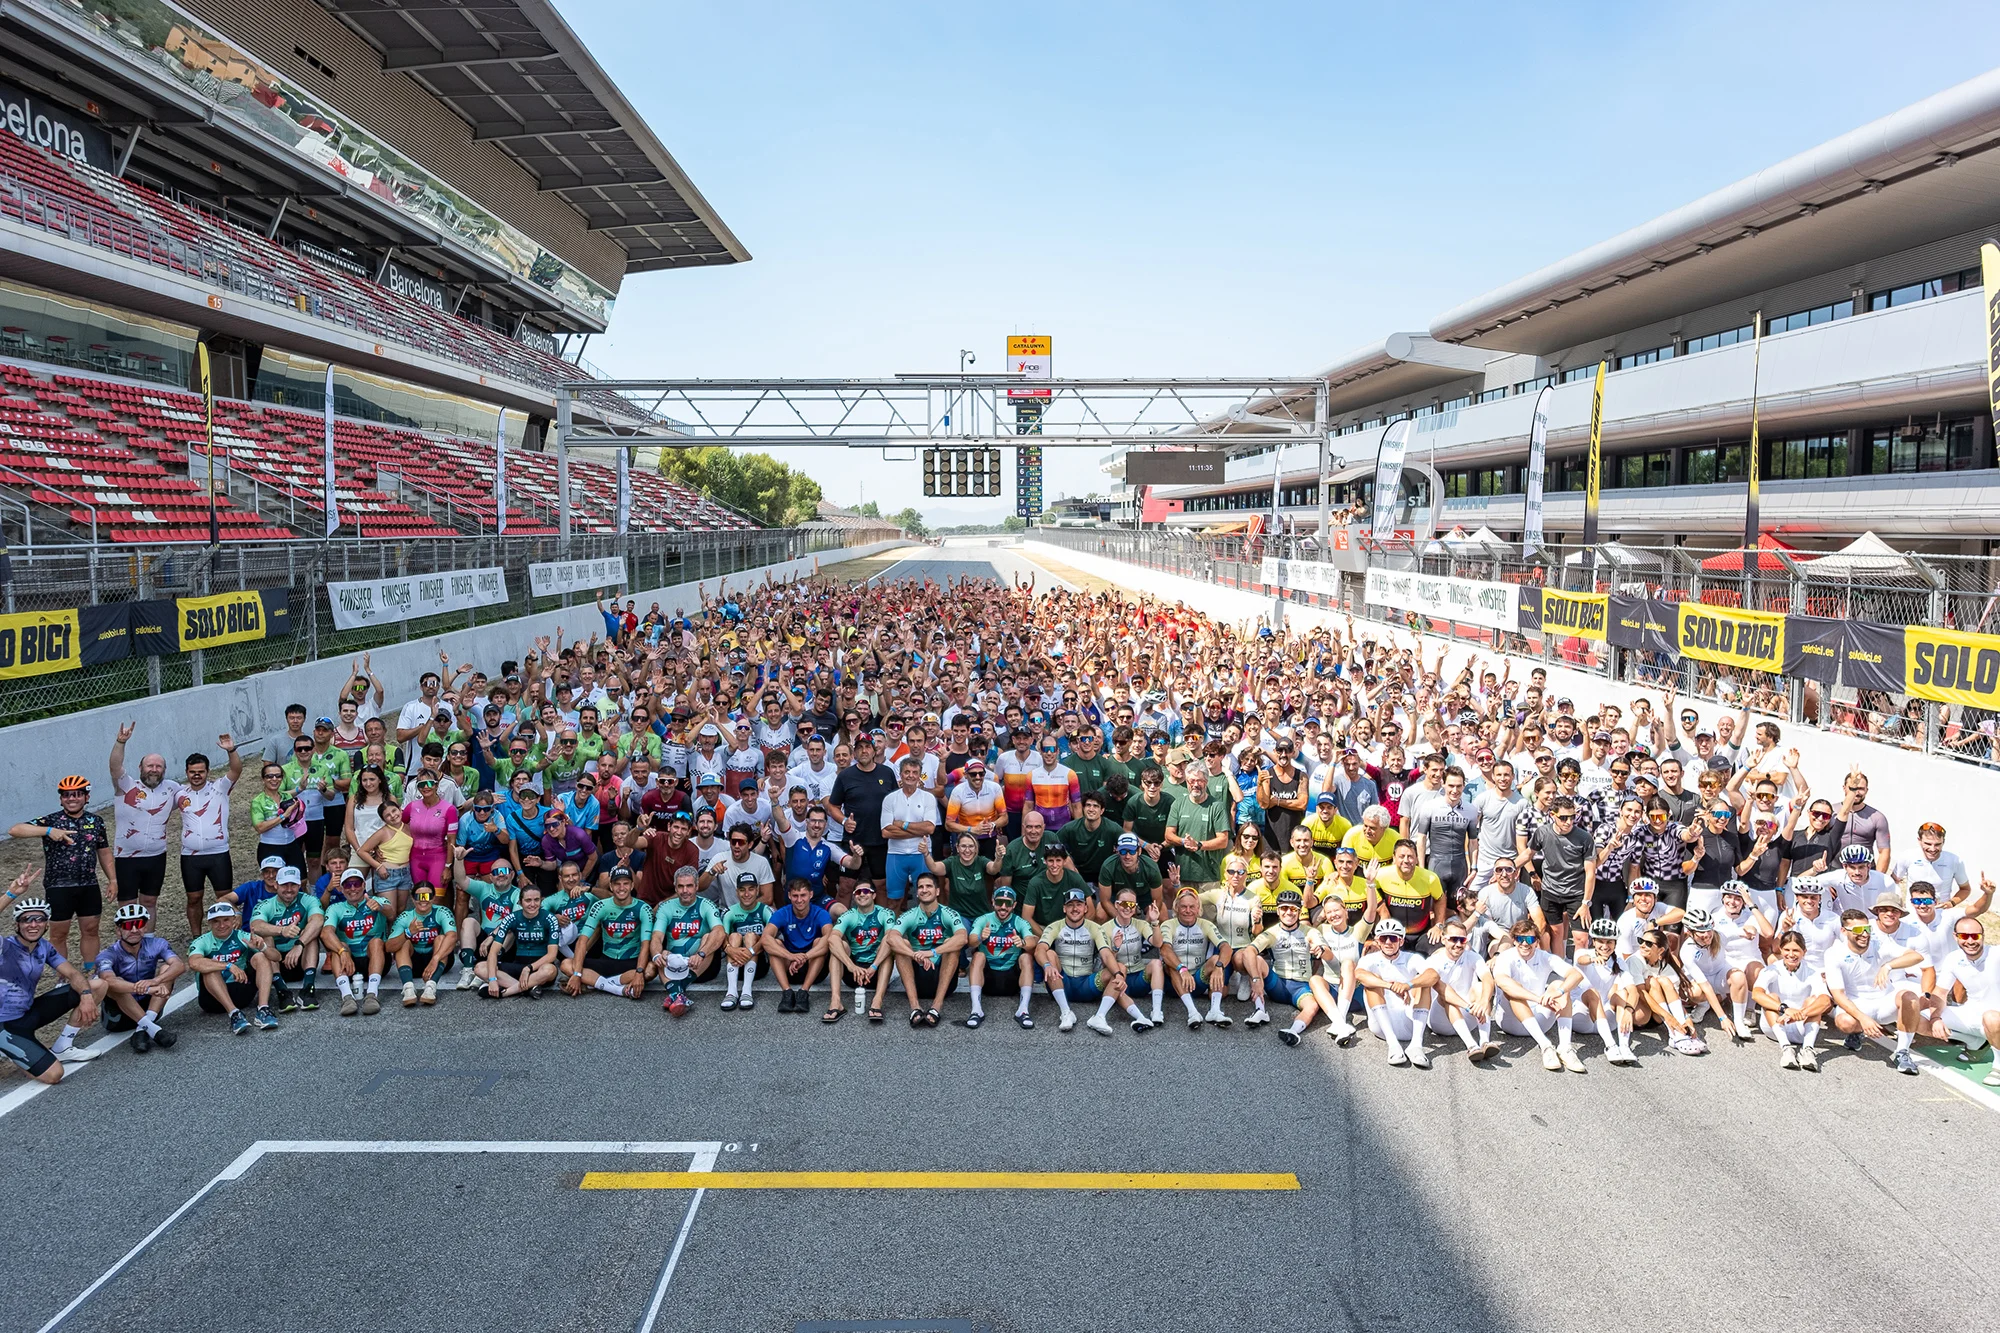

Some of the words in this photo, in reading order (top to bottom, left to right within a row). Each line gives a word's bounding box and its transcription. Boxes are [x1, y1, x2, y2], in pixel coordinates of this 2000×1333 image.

[389, 264, 443, 311] Barcelona
[213, 297, 222, 309] 15
[521, 324, 554, 355] Barcelona
[339, 587, 374, 612] FINISHER
[381, 583, 411, 607] FINISHER
[419, 578, 445, 601] FINISHER
[451, 574, 474, 597] FINISHER
[478, 573, 499, 592] FINISHER
[1478, 588, 1507, 612] FINISHER
[184, 605, 226, 641] SOLO
[228, 598, 261, 635] BICI
[1544, 598, 1579, 627] SOLO
[1579, 601, 1605, 631] BICI
[20, 618, 72, 666] BICI
[1683, 614, 1734, 653] SOLO
[1736, 620, 1779, 660] BICI
[1801, 643, 1835, 657] solobici.es
[1848, 649, 1882, 664] solobici.es
[1913, 641, 2000, 695] SOLO
[1390, 897, 1423, 906] MUNDO
[488, 902, 511, 915] KERN
[562, 905, 586, 917] KERN
[346, 917, 374, 928] KERN
[607, 922, 635, 930] KERN
[675, 922, 700, 930] KERN
[412, 930, 438, 940] KERN
[919, 928, 943, 936] KERN
[989, 936, 1014, 944] KERN
[212, 953, 241, 962] KERN
